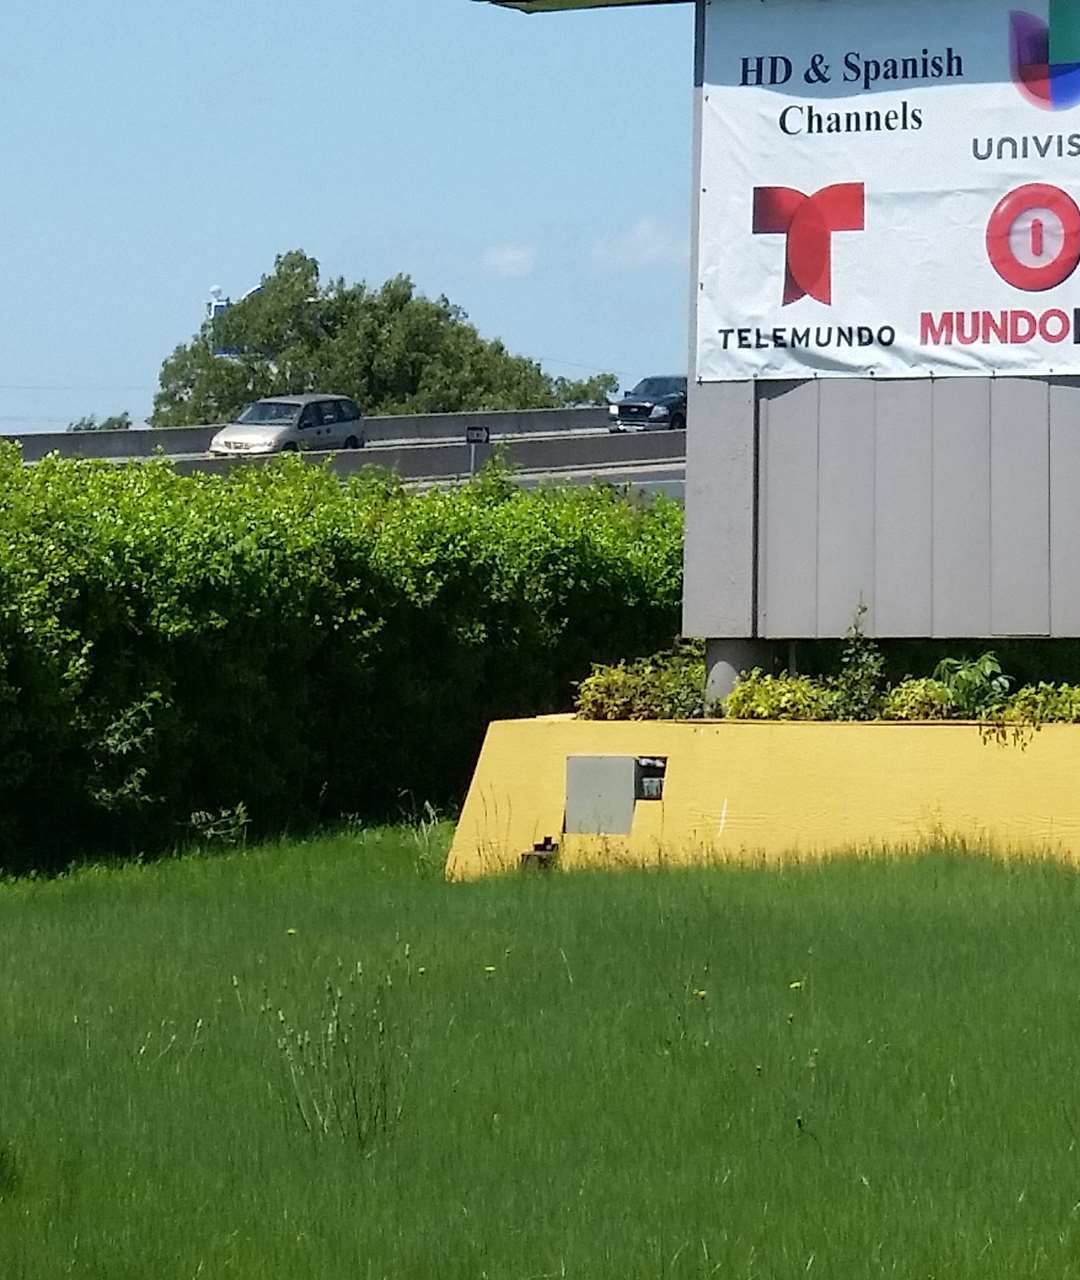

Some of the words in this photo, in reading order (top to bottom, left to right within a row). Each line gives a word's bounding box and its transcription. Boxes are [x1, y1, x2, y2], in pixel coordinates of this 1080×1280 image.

[738, 54, 793, 87] HD
[803, 52, 832, 85] &
[842, 47, 965, 90] Spanish
[778, 100, 924, 136] Channels
[717, 324, 896, 350] TELEMUNDO
